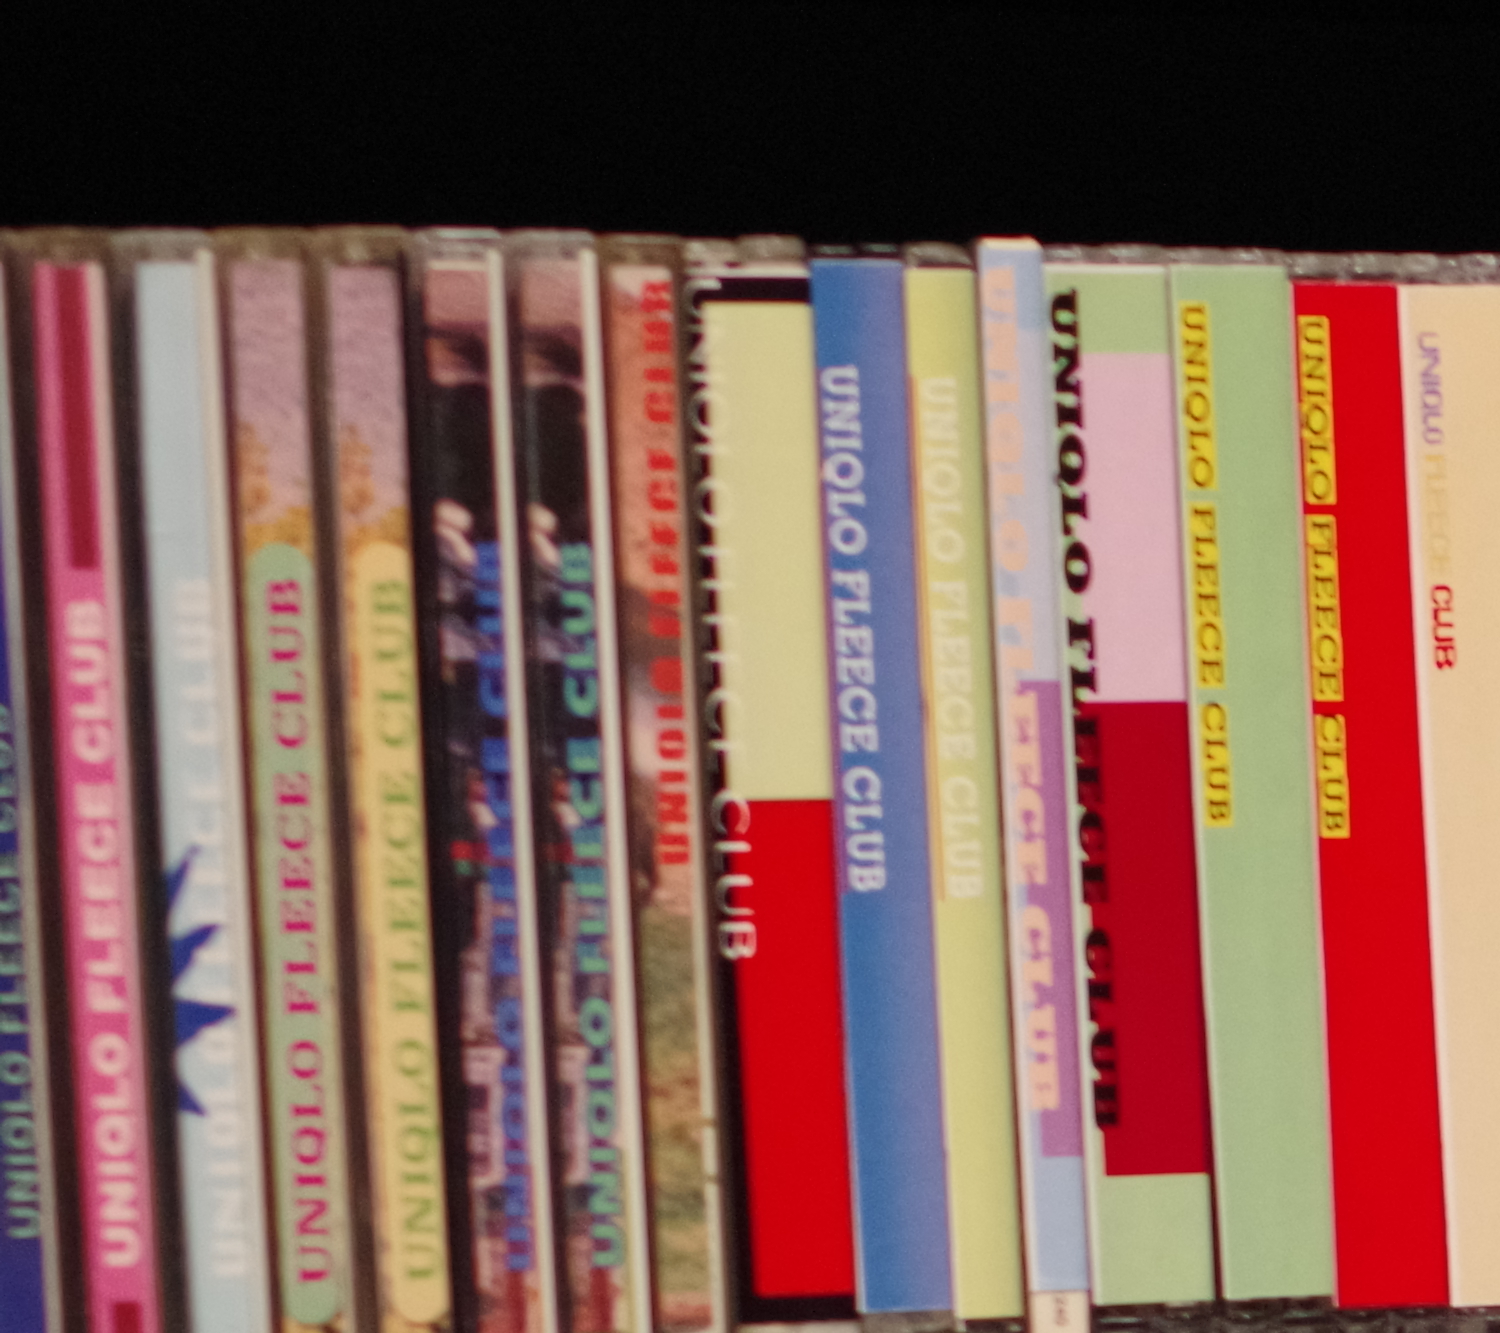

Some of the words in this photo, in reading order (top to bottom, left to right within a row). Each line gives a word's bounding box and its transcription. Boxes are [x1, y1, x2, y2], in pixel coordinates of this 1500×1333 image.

[820, 365, 868, 556] UNIQLO
[1181, 303, 1218, 490] UNIQLO
[1299, 318, 1336, 503] UNIQLO
[62, 600, 115, 764] CLUB
[265, 580, 310, 750] CLUB
[834, 568, 878, 754] FLEECE
[1190, 502, 1226, 689] FLEECE
[1307, 518, 1342, 700] FLEECE
[843, 765, 888, 892] CLUB
[1199, 702, 1233, 828] CLUB
[1315, 714, 1351, 840] CLUB
[73, 782, 128, 1014] FLEECE
[273, 772, 321, 1015] FLEECE
[88, 1032, 143, 1268] UNIQLO
[287, 1040, 335, 1282] UNIQLO
